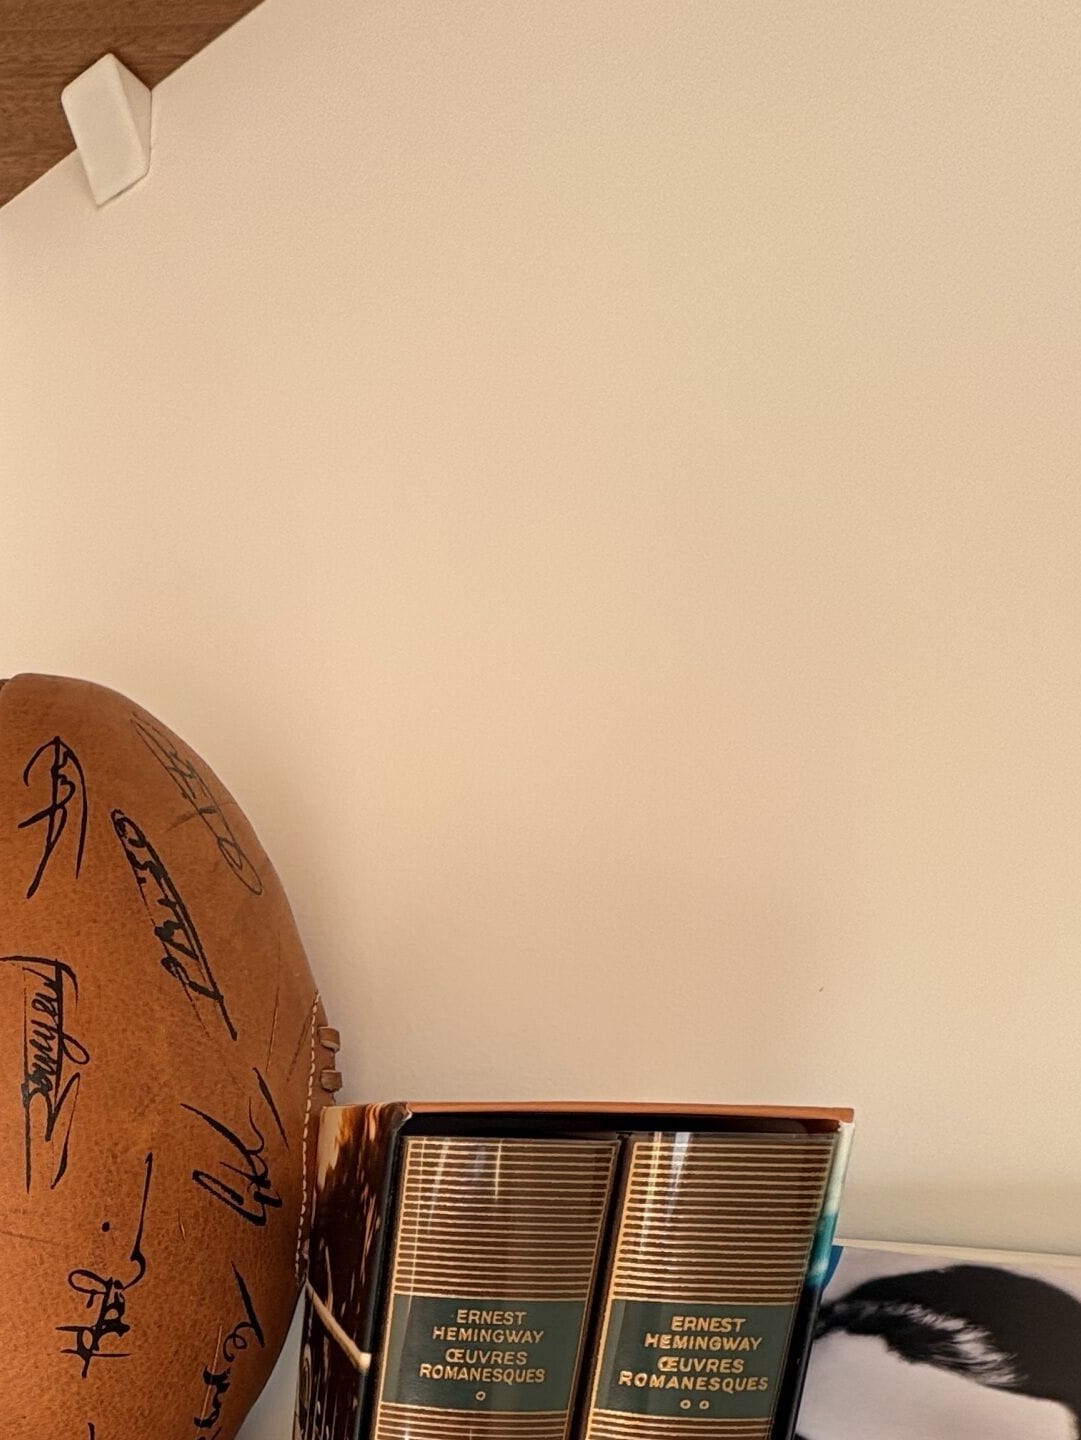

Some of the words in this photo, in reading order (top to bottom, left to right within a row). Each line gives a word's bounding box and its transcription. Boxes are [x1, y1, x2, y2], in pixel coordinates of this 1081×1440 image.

[456, 1308, 528, 1325] ERNEST
[670, 1315, 747, 1333] ERNEST
[431, 1326, 544, 1344] HEMINGWAY
[643, 1332, 763, 1351] HEMINGWAY
[444, 1348, 529, 1366] ŒUVRES
[657, 1355, 745, 1374] ŒUVRES
[419, 1363, 546, 1386] ROMANESQUES
[617, 1370, 769, 1394] ROMANESQUES
